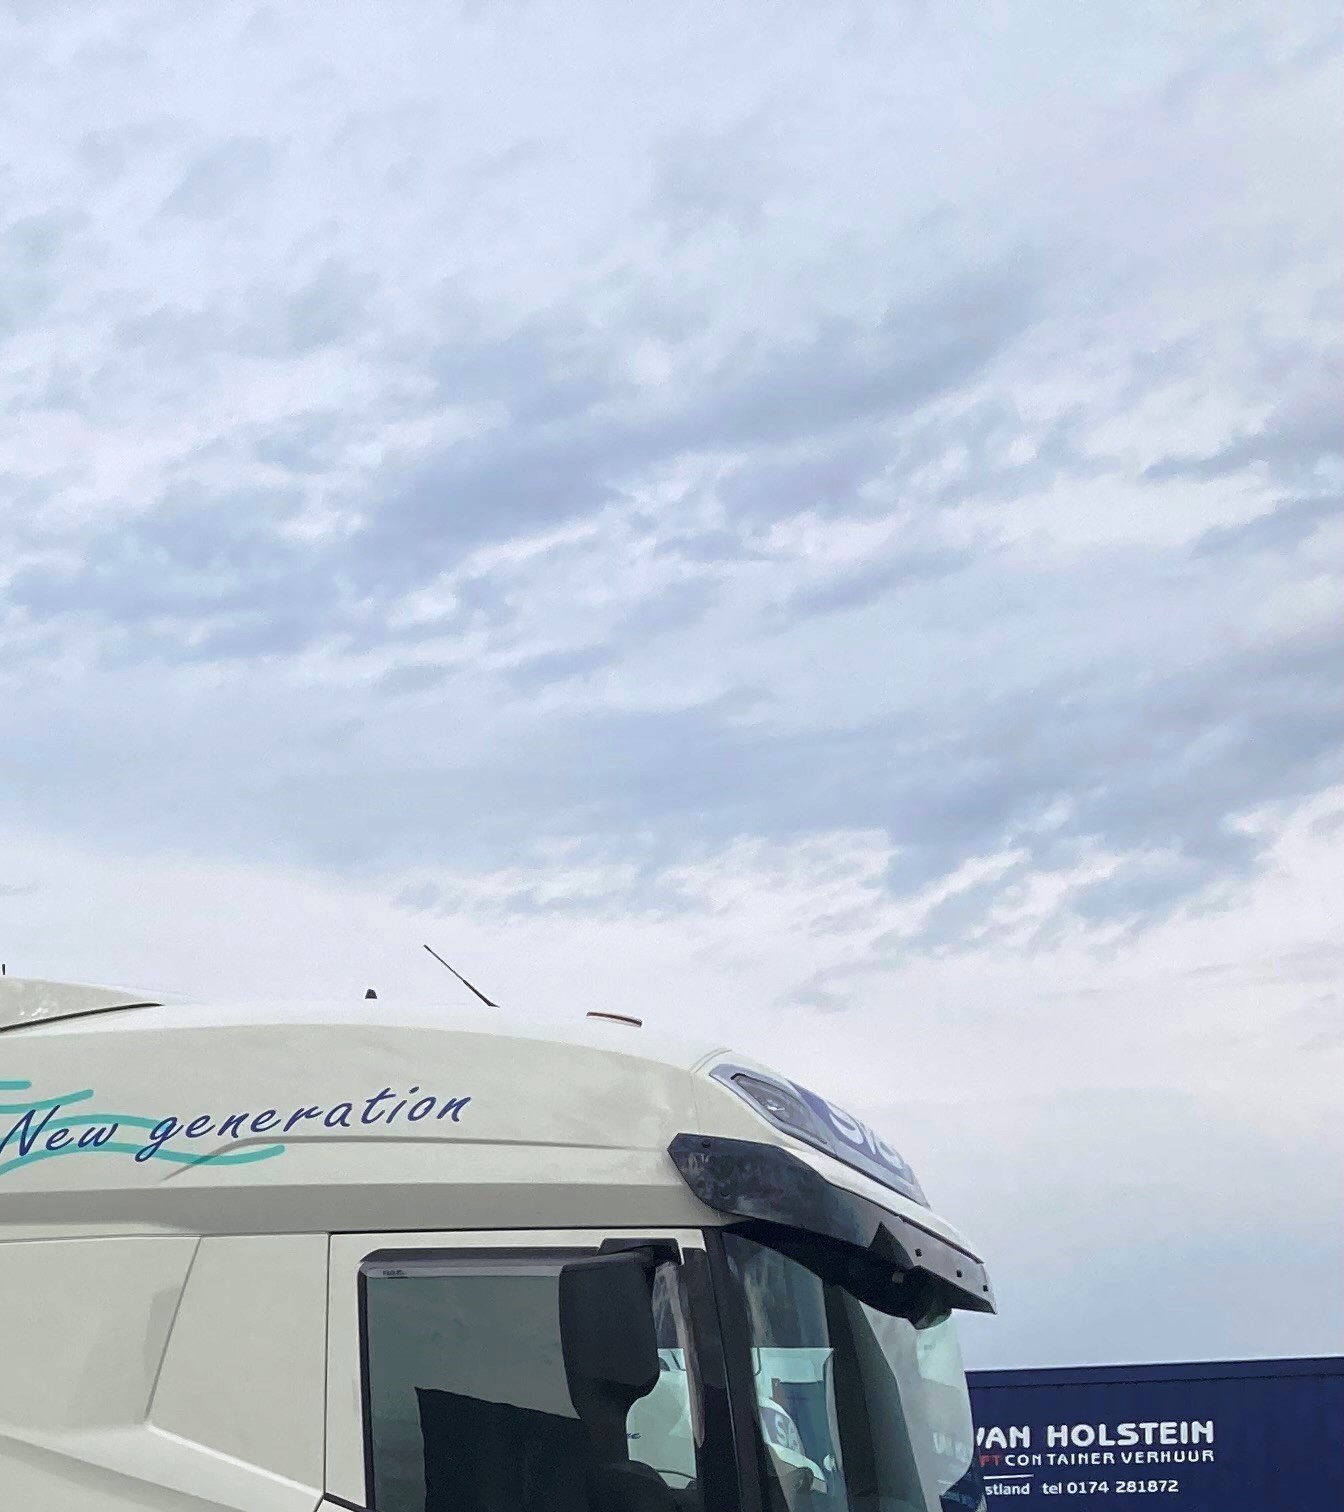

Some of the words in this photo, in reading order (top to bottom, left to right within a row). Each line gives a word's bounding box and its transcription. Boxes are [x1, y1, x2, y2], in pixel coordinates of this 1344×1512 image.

[133, 1085, 472, 1163] generation
[1047, 1420, 1214, 1447] HOLSTEIN
[1042, 1481, 1062, 1495] tel
[1066, 1480, 1110, 1495] 0174
[1115, 1479, 1179, 1494] 281872
